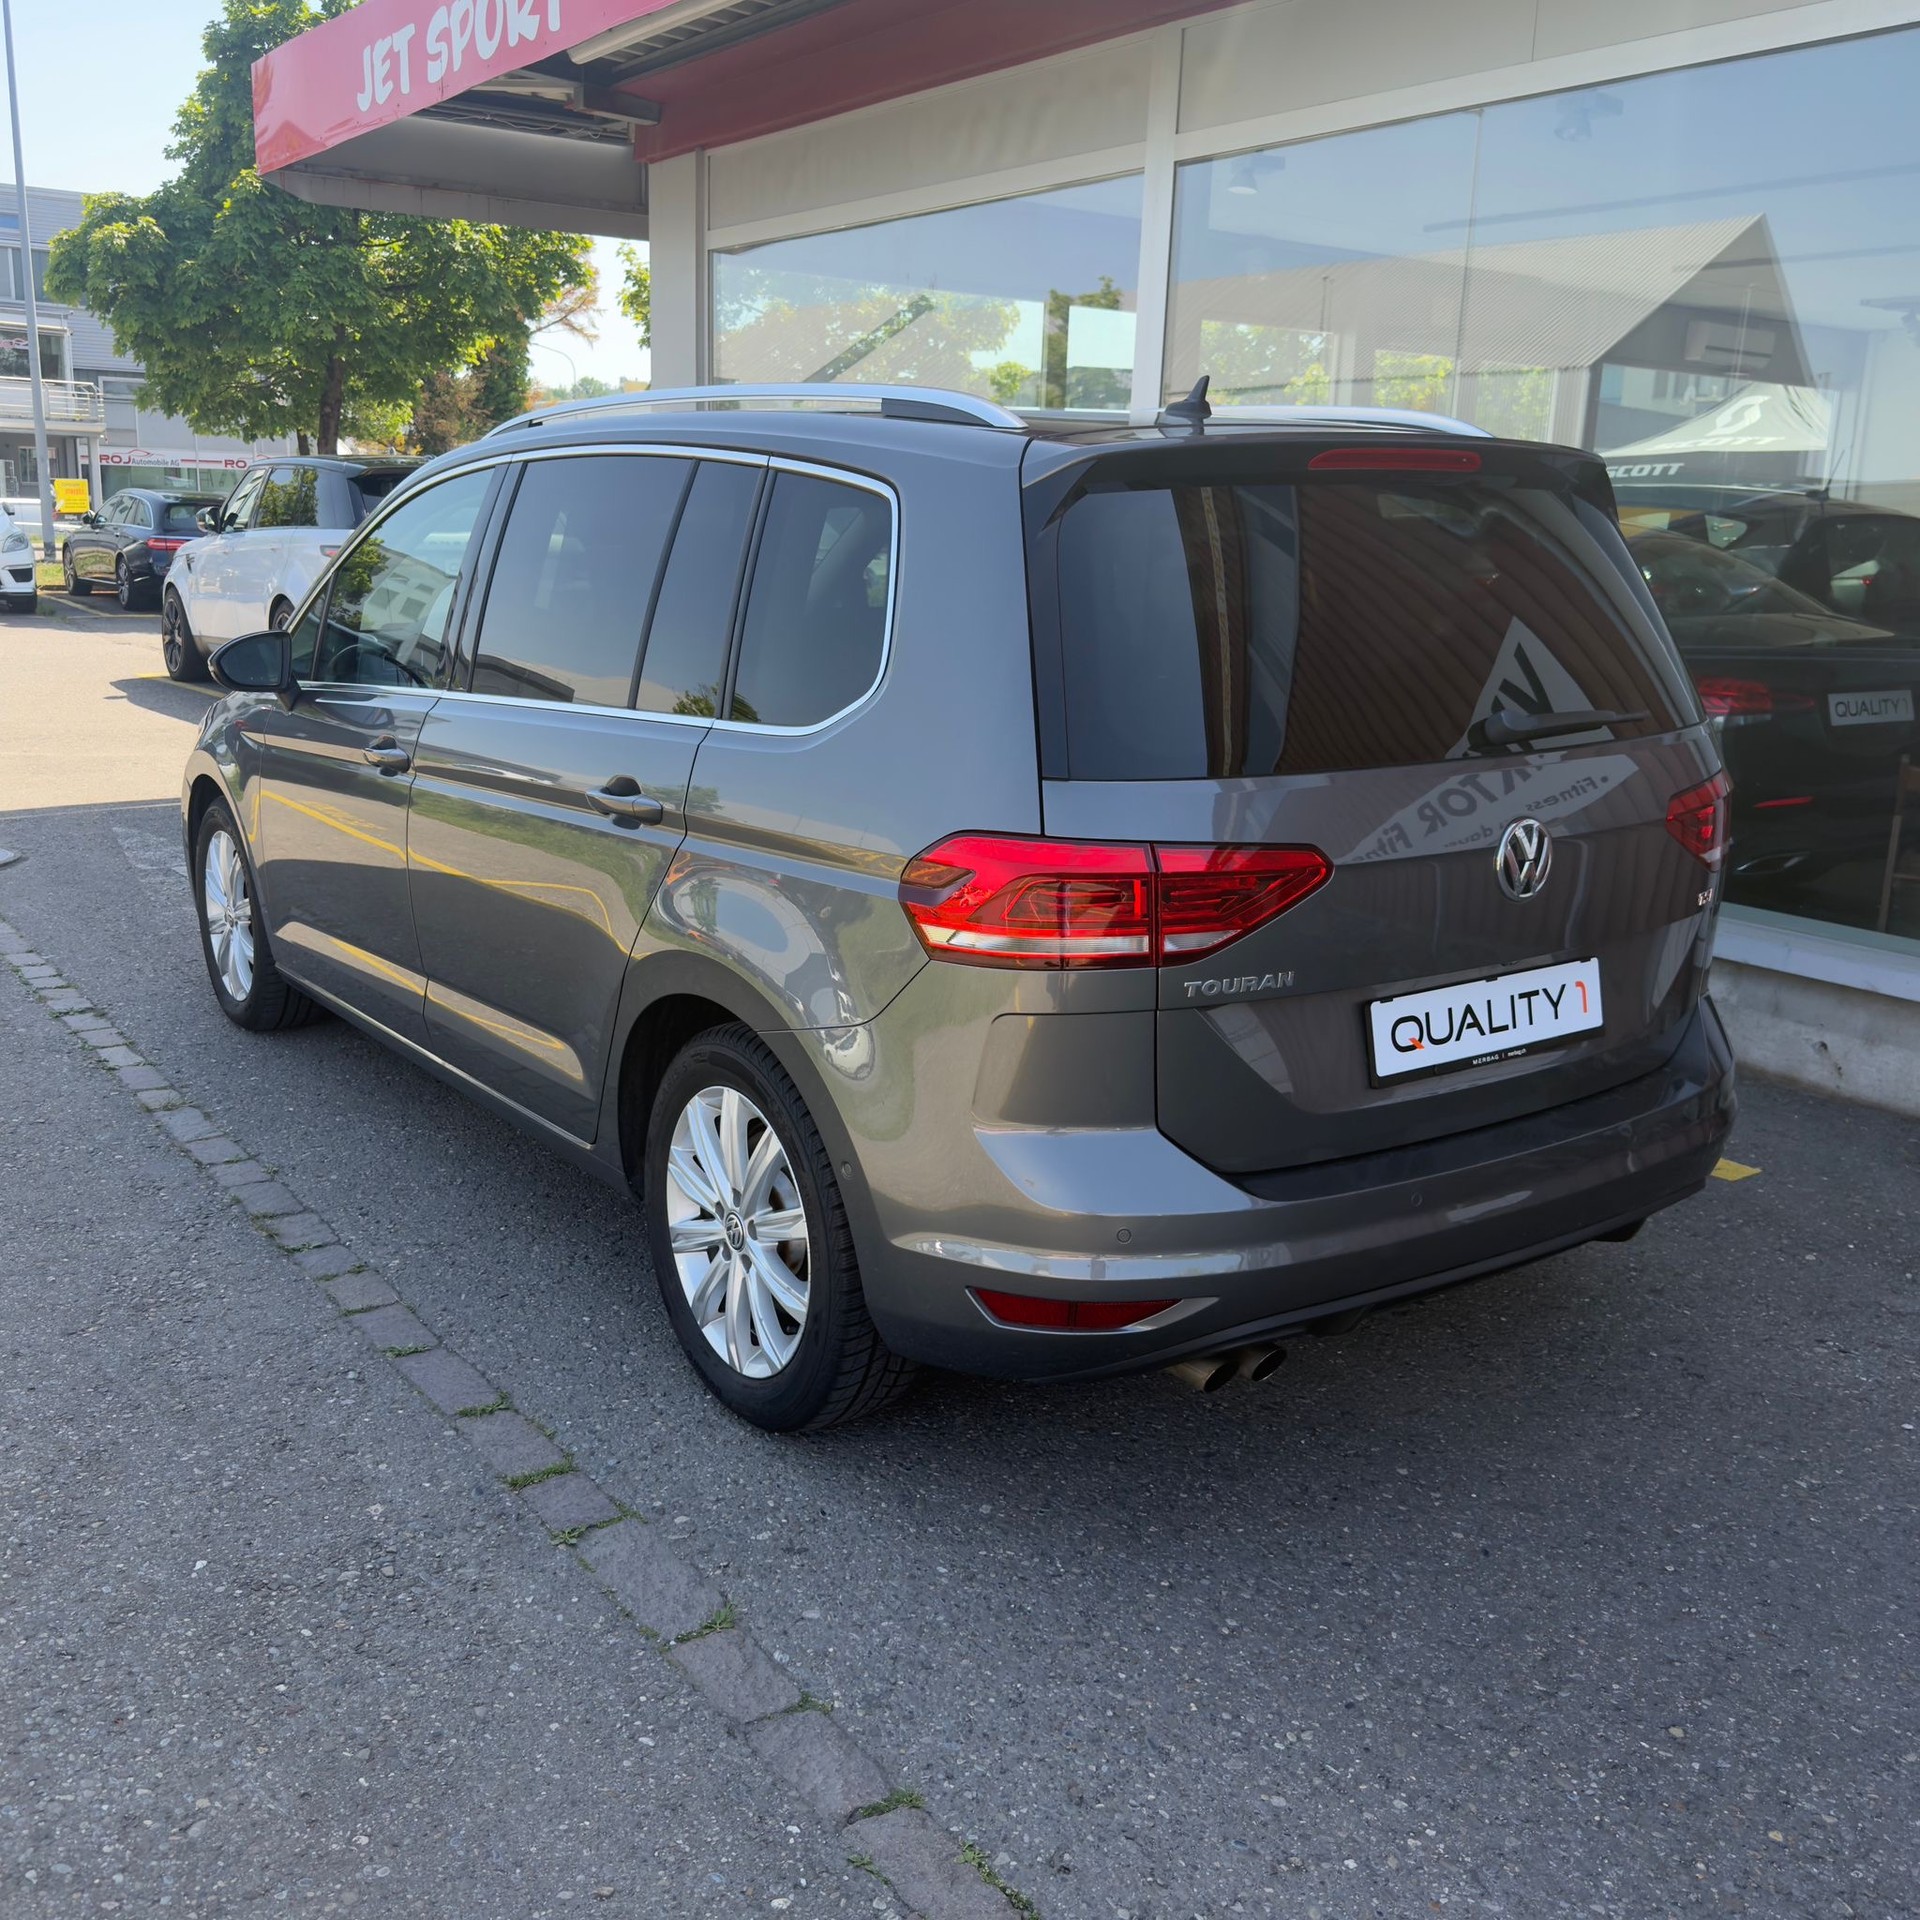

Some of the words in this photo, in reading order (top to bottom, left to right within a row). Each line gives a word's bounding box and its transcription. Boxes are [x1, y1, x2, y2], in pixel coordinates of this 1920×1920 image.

[357, 23, 416, 112] JET
[99, 454, 132, 465] ROJ
[131, 458, 170, 467] Automobile
[170, 459, 180, 467] AG
[224, 459, 248, 469] RO
[1835, 698, 1899, 717] QUALITY
[1184, 971, 1295, 998] TOURAN
[1390, 983, 1566, 1053] QUALITY
[1574, 980, 1588, 1014] 1
